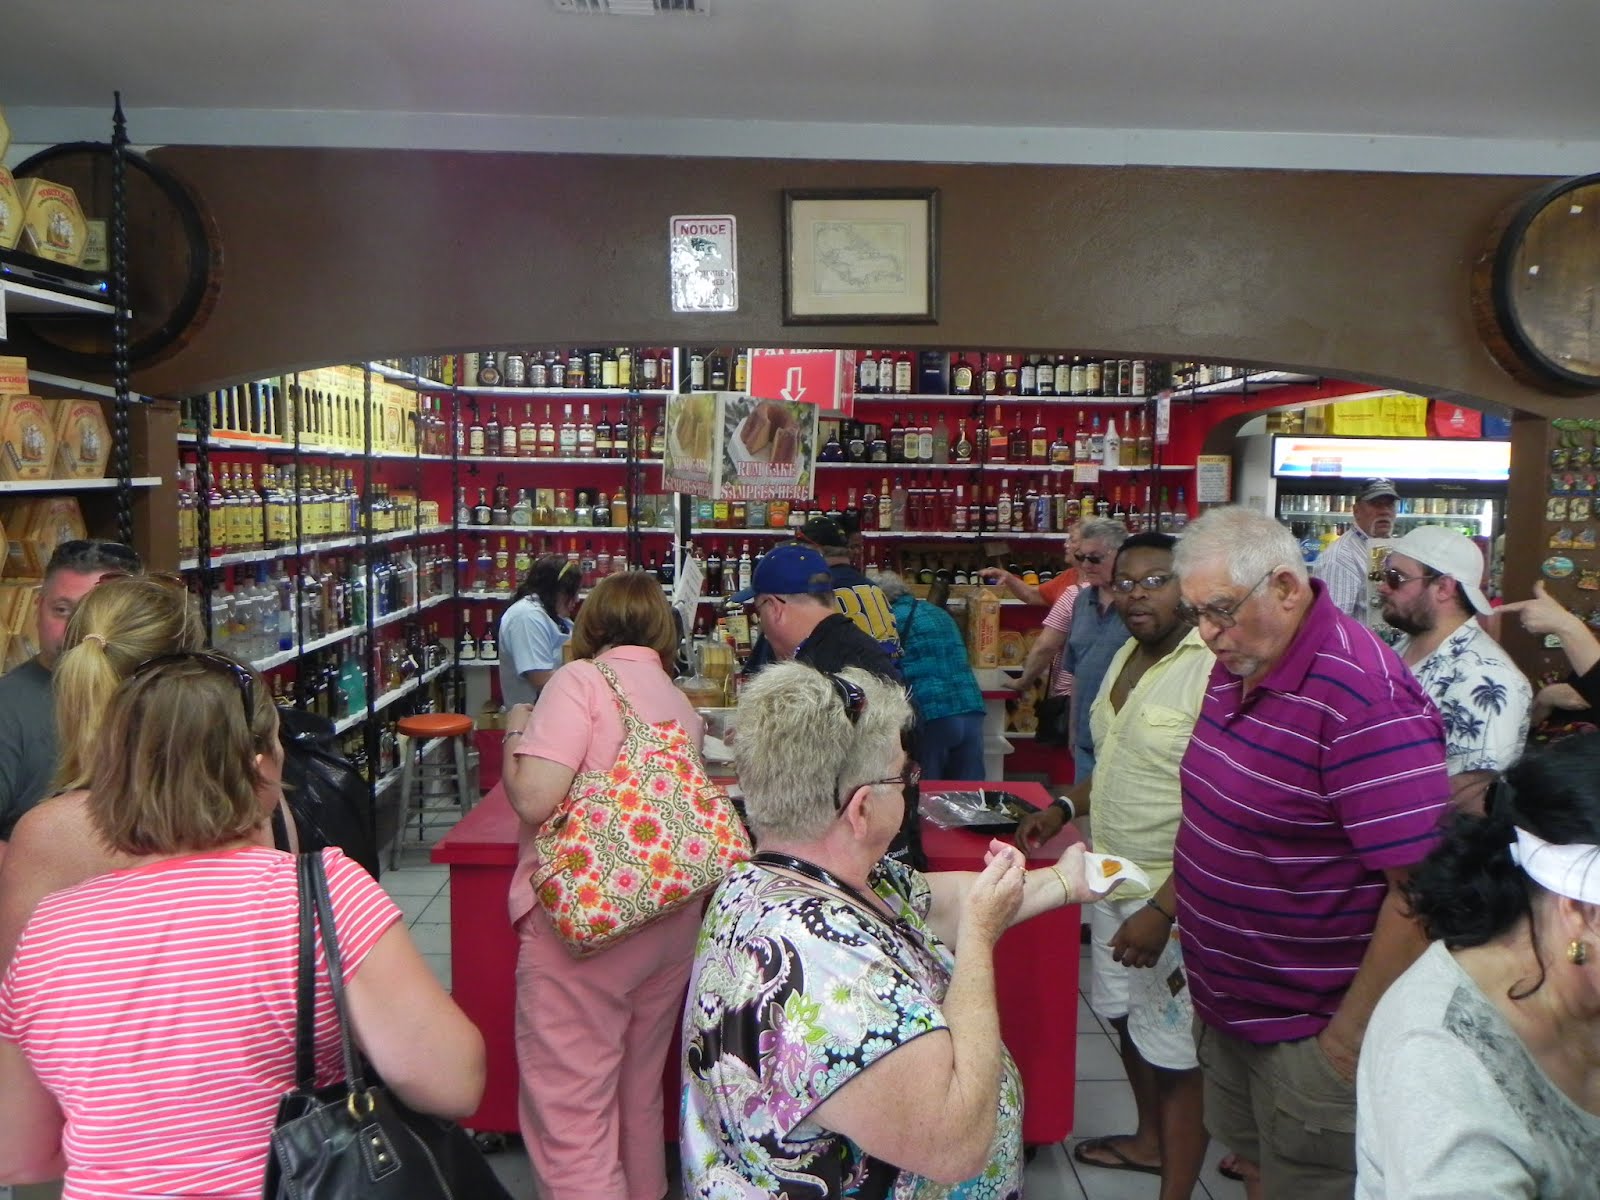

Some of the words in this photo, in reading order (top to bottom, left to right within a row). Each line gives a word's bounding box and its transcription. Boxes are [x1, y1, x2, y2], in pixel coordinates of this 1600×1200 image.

[680, 224, 726, 235] NOTICE
[737, 461, 763, 477] RUM
[765, 463, 796, 478] CAKE
[720, 484, 775, 500] SAMPLES
[777, 485, 810, 500] HERE
